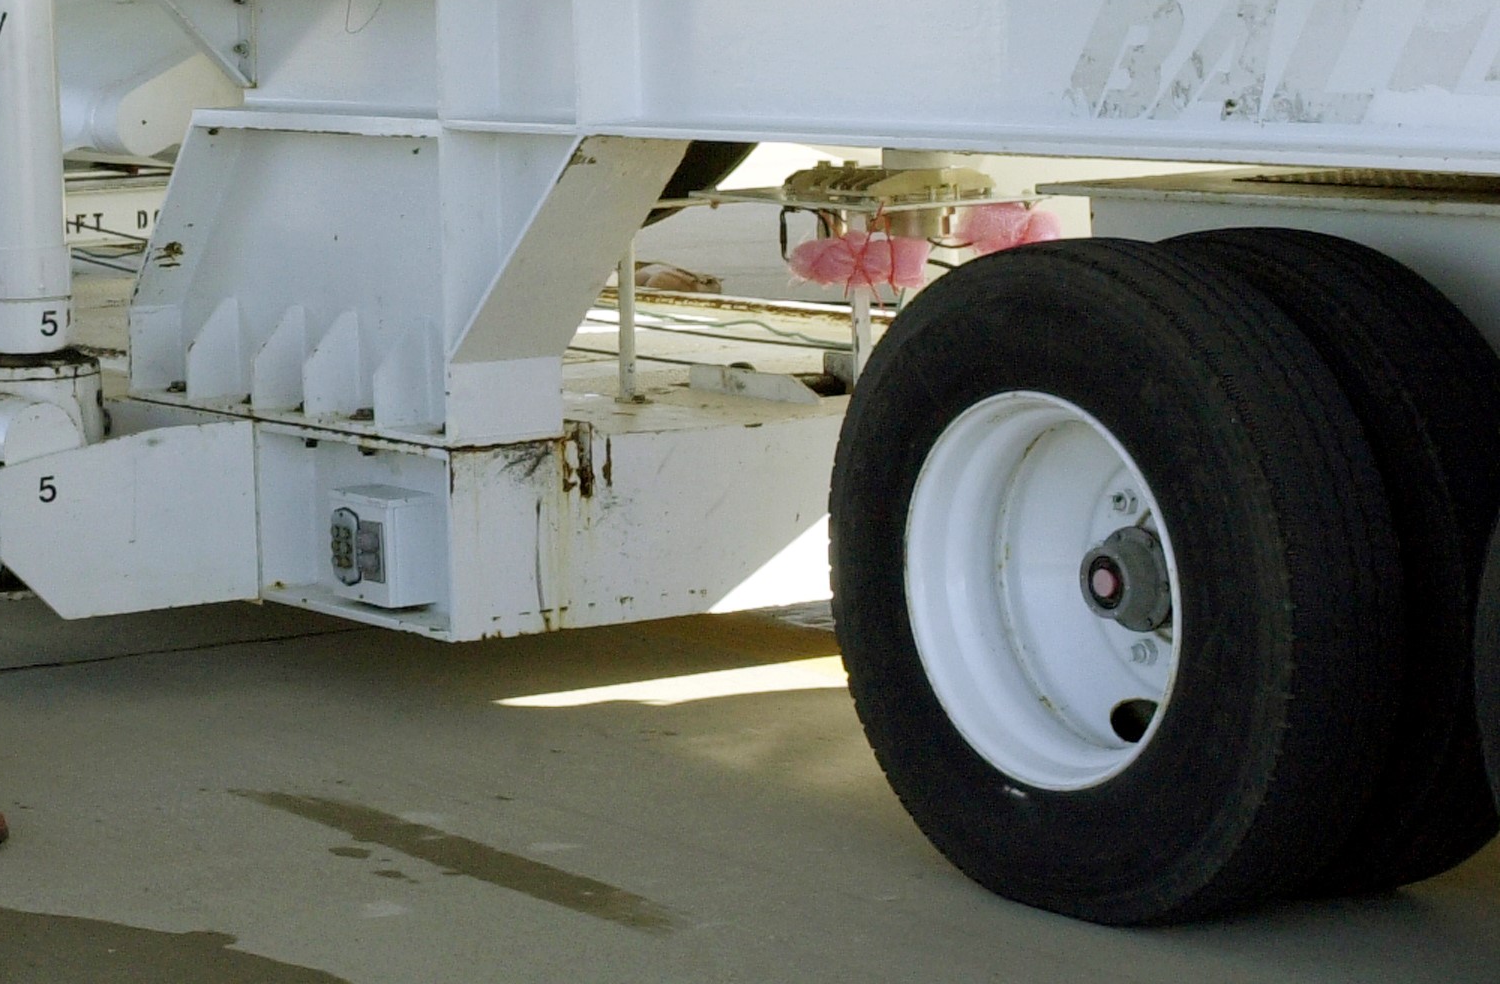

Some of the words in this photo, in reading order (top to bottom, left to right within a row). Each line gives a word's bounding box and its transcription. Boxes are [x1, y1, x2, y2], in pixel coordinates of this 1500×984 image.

[136, 209, 160, 230] D
[40, 309, 59, 337] 5
[38, 475, 58, 503] 5
